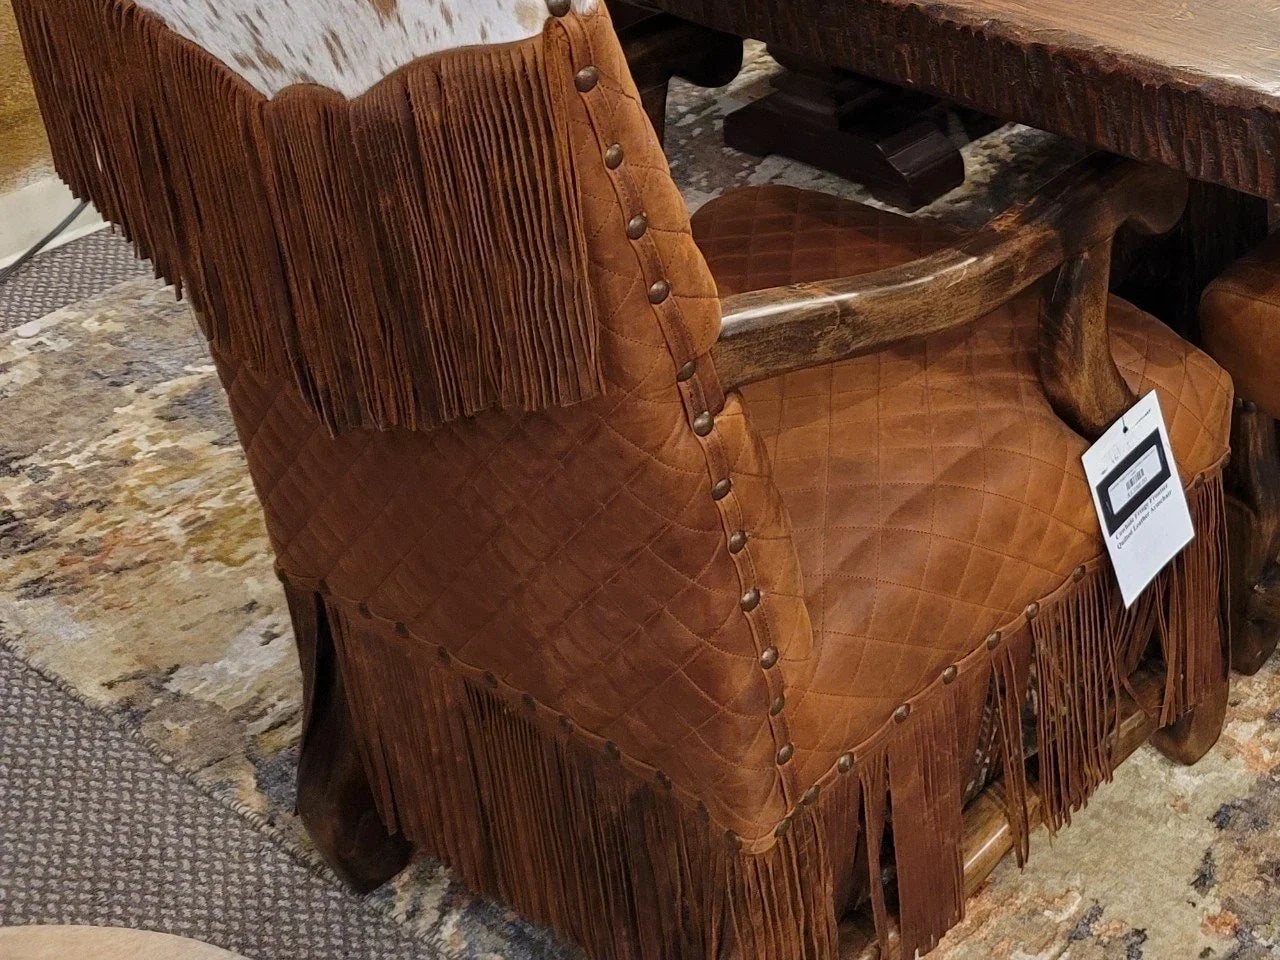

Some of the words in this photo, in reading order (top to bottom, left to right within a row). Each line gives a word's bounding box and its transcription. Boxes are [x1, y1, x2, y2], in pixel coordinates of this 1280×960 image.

[1115, 518, 1135, 540] Cowhide
[1134, 502, 1149, 520] Fringe
[1149, 483, 1168, 504] Frontier
[1133, 512, 1150, 532] Leather
[1150, 489, 1172, 513] Armchair
